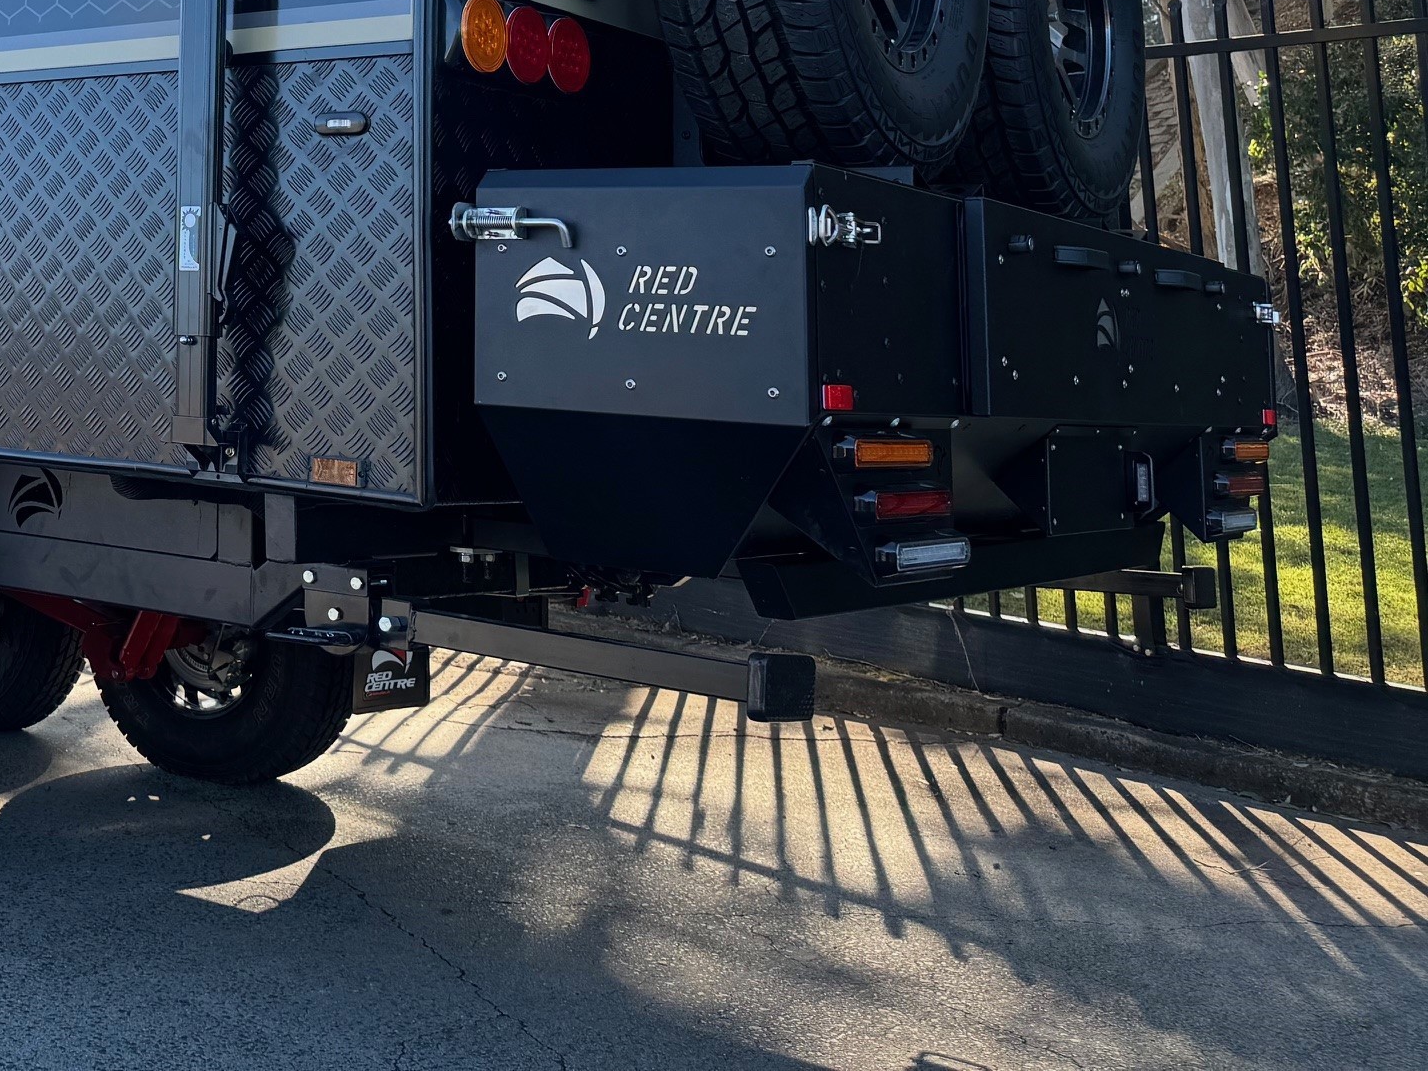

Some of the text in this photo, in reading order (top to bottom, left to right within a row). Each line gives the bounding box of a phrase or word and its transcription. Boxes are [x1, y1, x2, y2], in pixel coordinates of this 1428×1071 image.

[628, 265, 698, 295] RED
[618, 303, 758, 336] CENTRE
[364, 677, 416, 693] CENTRE
[366, 670, 393, 684] RED
